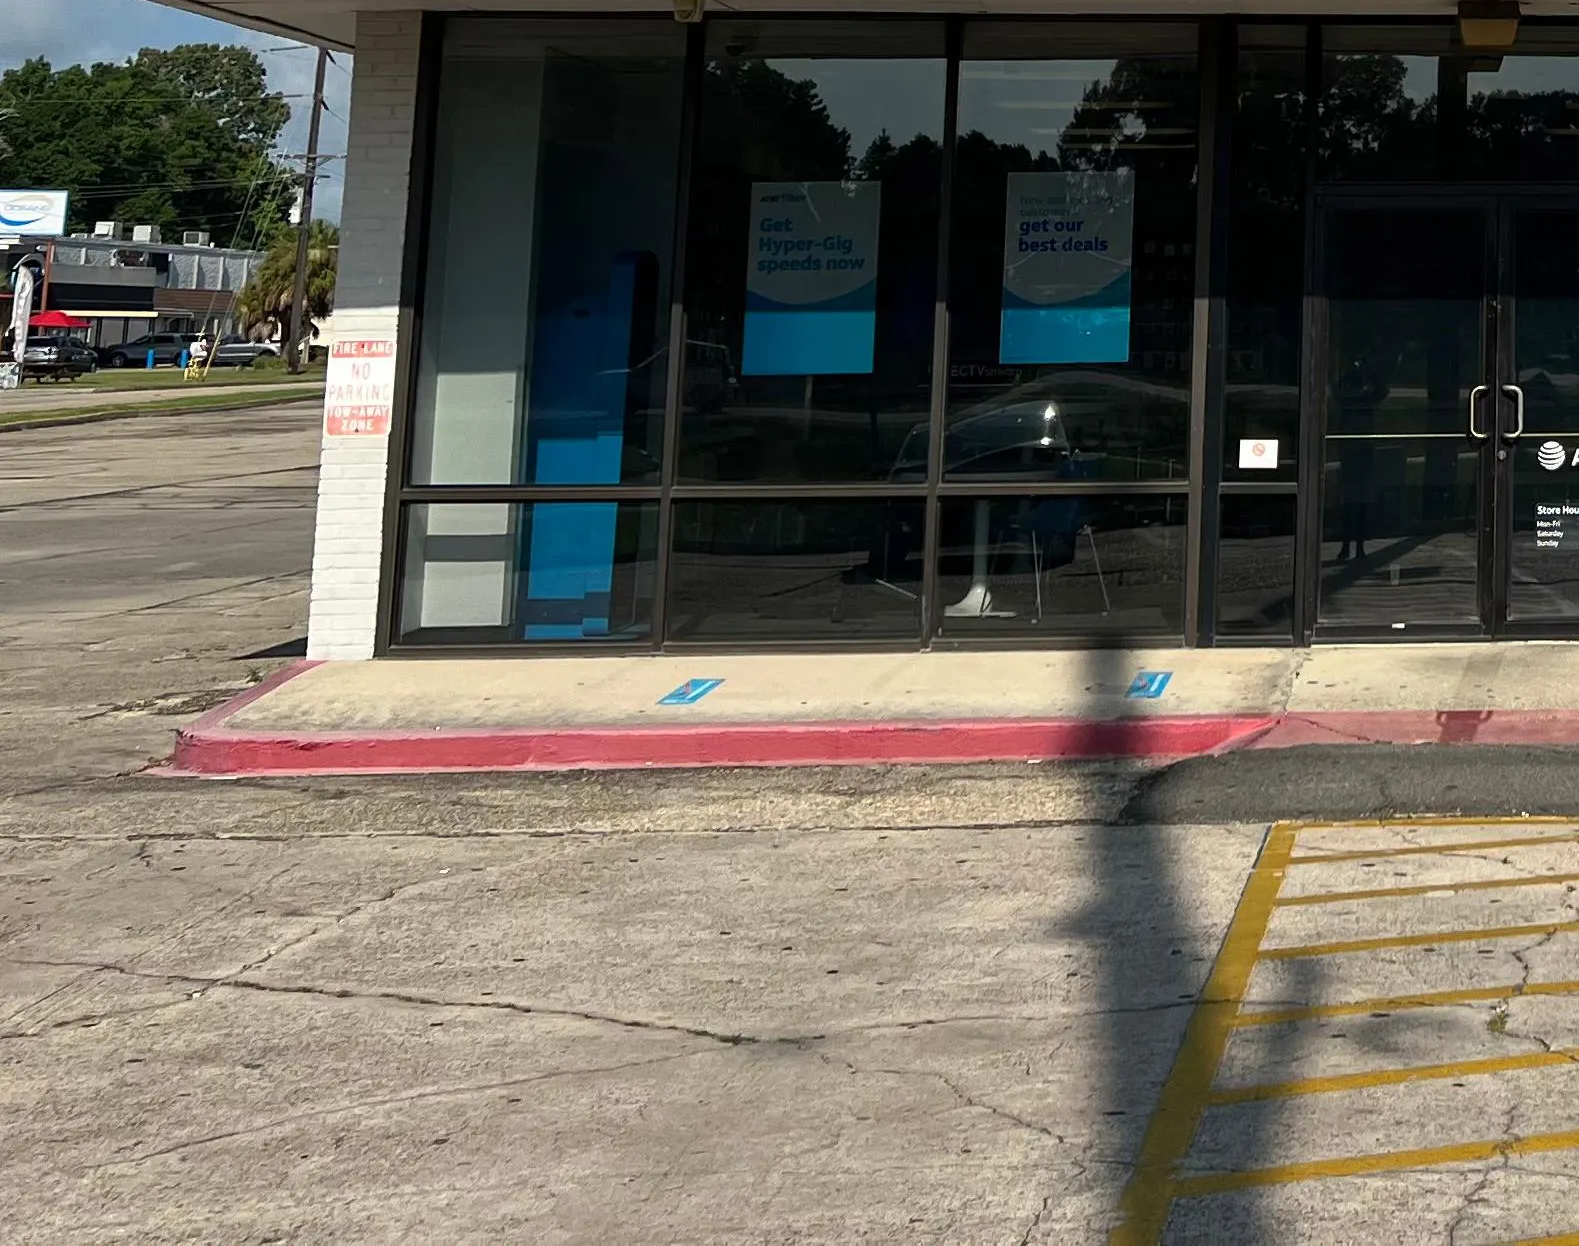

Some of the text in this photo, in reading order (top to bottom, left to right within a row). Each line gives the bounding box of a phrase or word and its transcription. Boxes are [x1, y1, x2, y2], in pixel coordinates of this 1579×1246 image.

[760, 218, 793, 232] Get
[1020, 219, 1084, 236] get our
[759, 235, 853, 255] Hyper-Gig
[1018, 236, 1108, 252] best deals
[758, 255, 865, 275] speeds now
[332, 341, 392, 354] FIRE LANE
[351, 362, 370, 380] NO
[328, 383, 390, 403] PARKING
[341, 419, 375, 432] ZONE
[1537, 505, 1561, 515] Store
[1537, 530, 1564, 538] Saturday
[1537, 539, 1559, 548] Sunday
